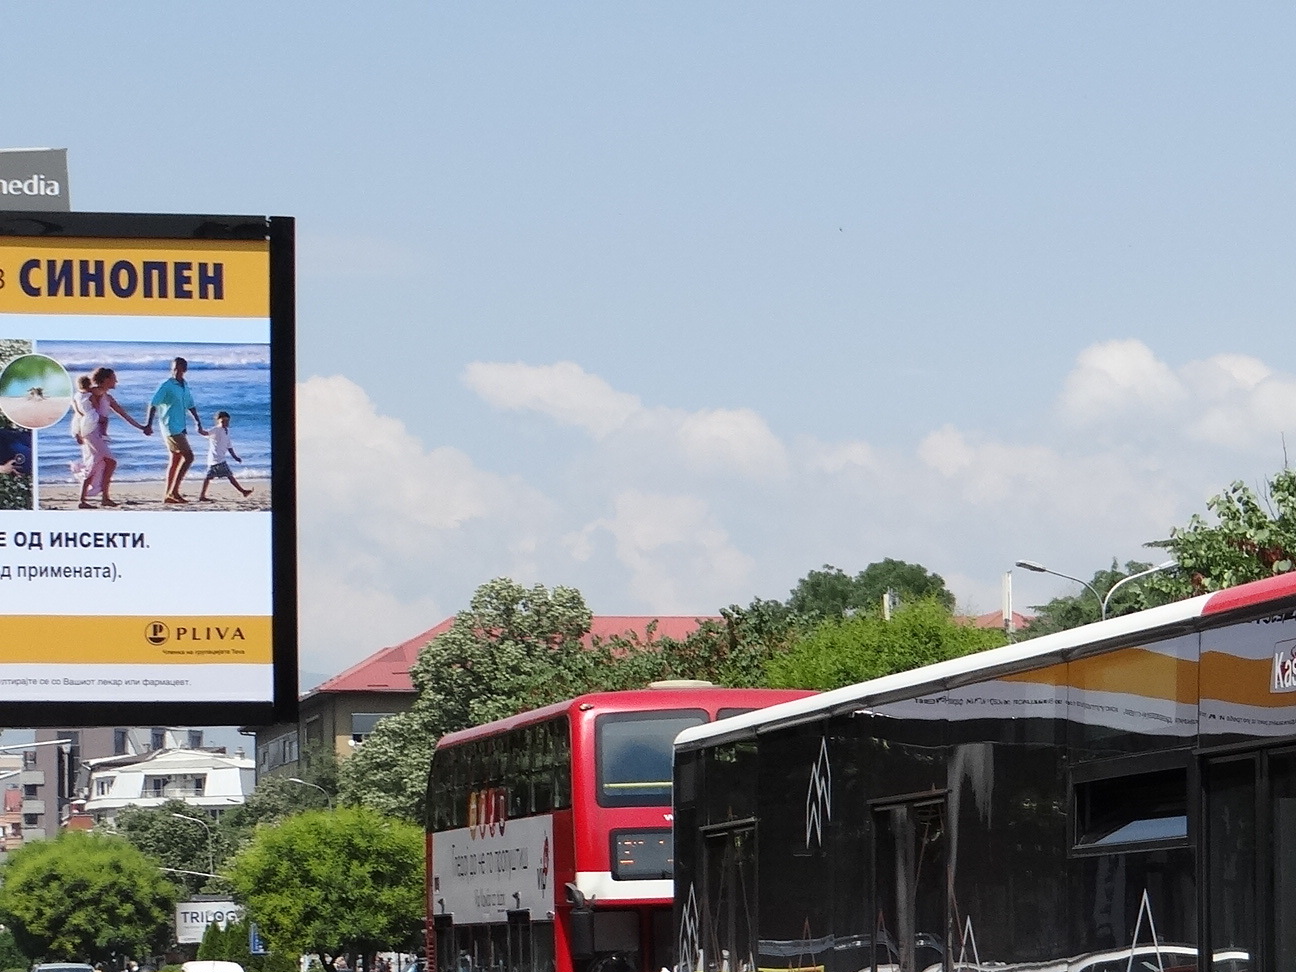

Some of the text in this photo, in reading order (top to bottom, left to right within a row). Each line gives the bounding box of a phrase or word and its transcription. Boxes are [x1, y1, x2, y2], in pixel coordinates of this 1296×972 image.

[19, 258, 225, 300] СИНОПЕН
[14, 531, 43, 550] ОД
[50, 531, 151, 549] ИНСЕКТИ.
[17, 562, 122, 582] примената).
[176, 627, 245, 640] PLIVA
[63, 677, 95, 686] Вашиот
[97, 679, 123, 687] лекар
